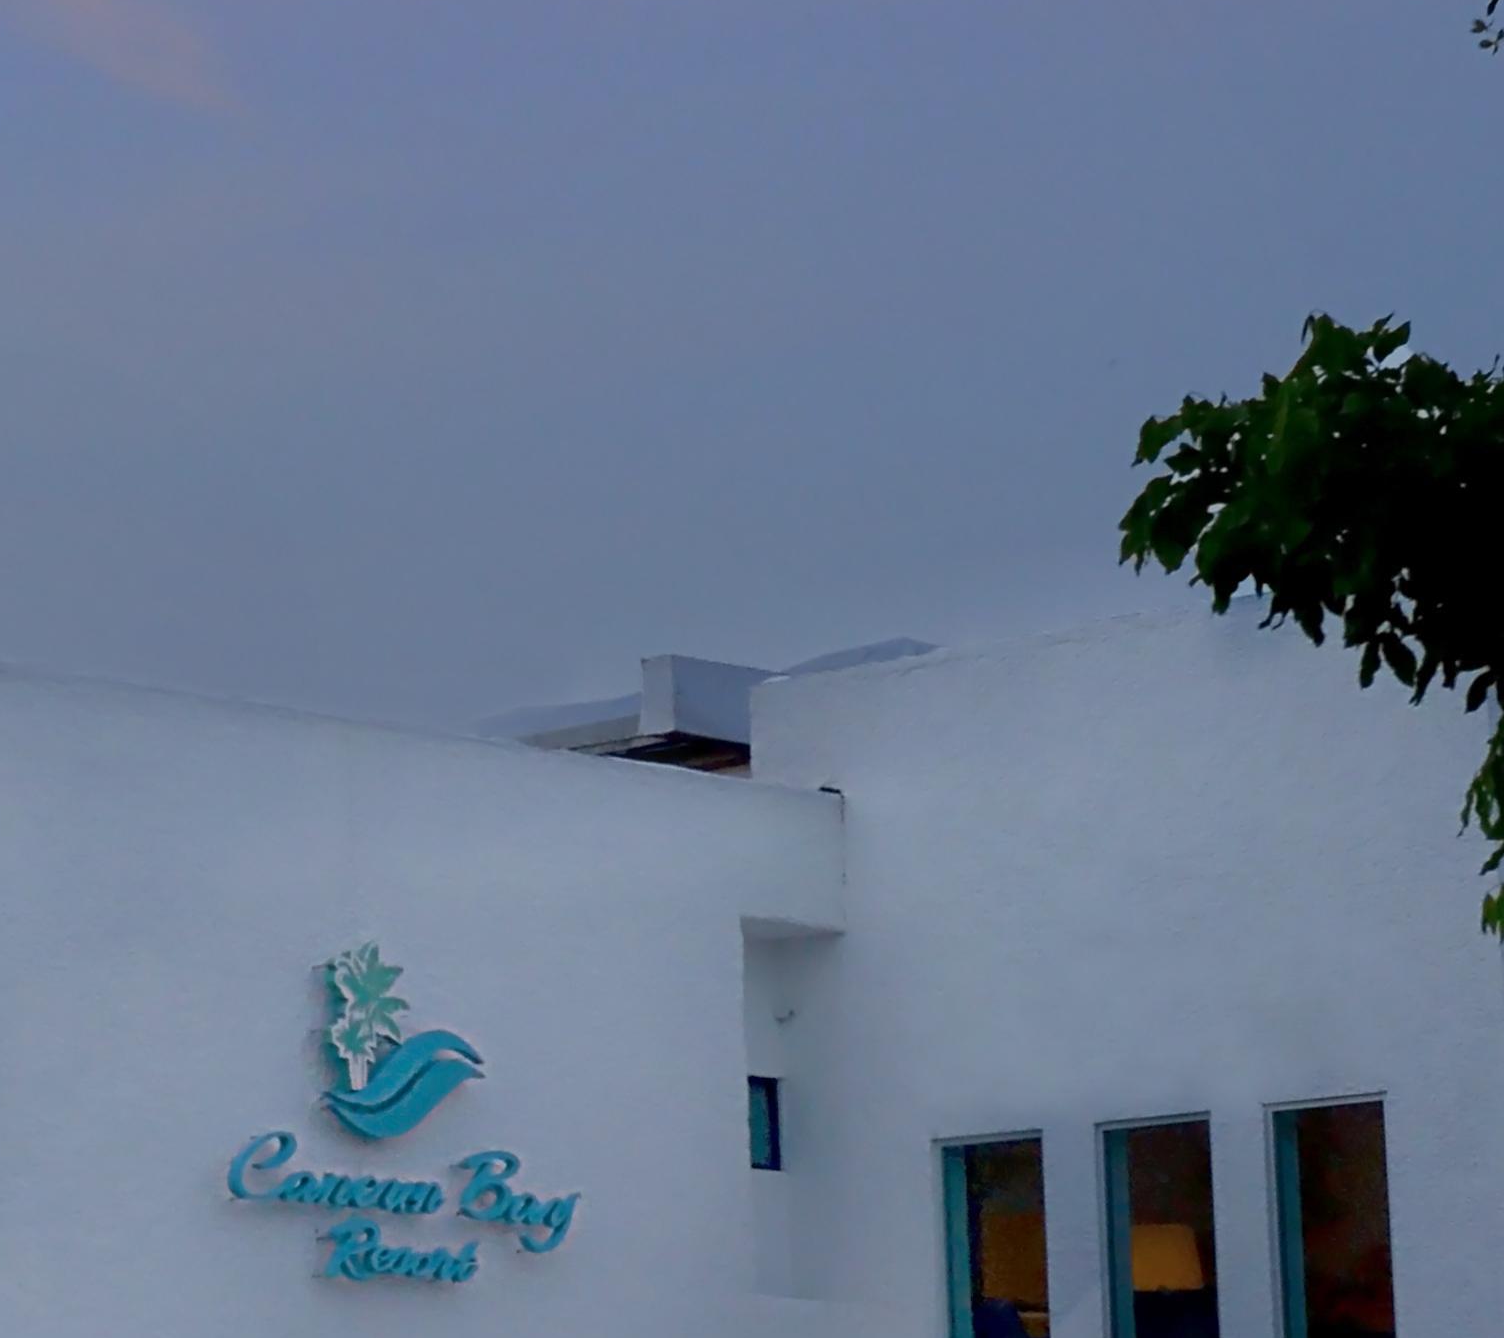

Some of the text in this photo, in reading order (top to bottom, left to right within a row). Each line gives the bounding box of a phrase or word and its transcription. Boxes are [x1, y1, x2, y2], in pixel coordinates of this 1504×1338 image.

[227, 1130, 582, 1254] Cancun Bay
[318, 1216, 480, 1284] Resort
